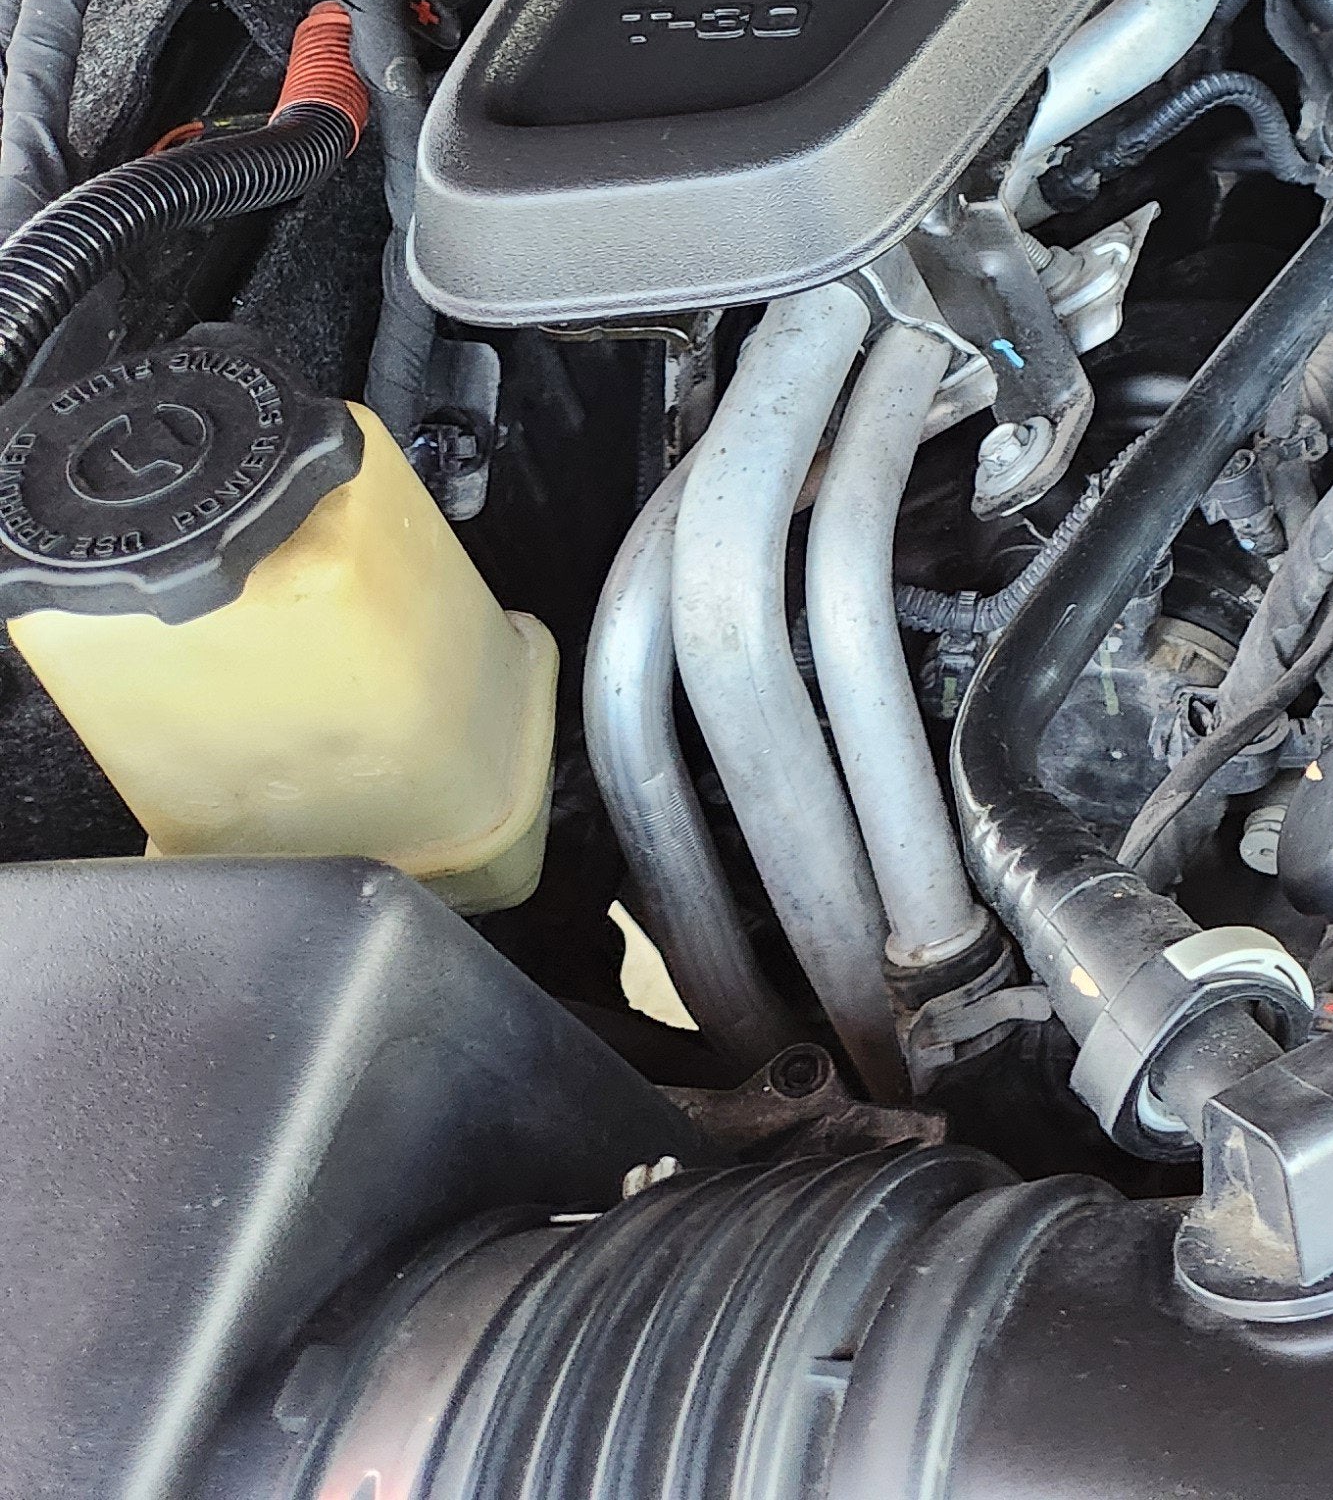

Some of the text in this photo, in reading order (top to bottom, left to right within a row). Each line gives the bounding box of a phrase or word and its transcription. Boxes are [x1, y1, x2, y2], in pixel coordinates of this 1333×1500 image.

[50, 352, 284, 532] POWER STEERING FLUID
[69, 529, 144, 558] USE
